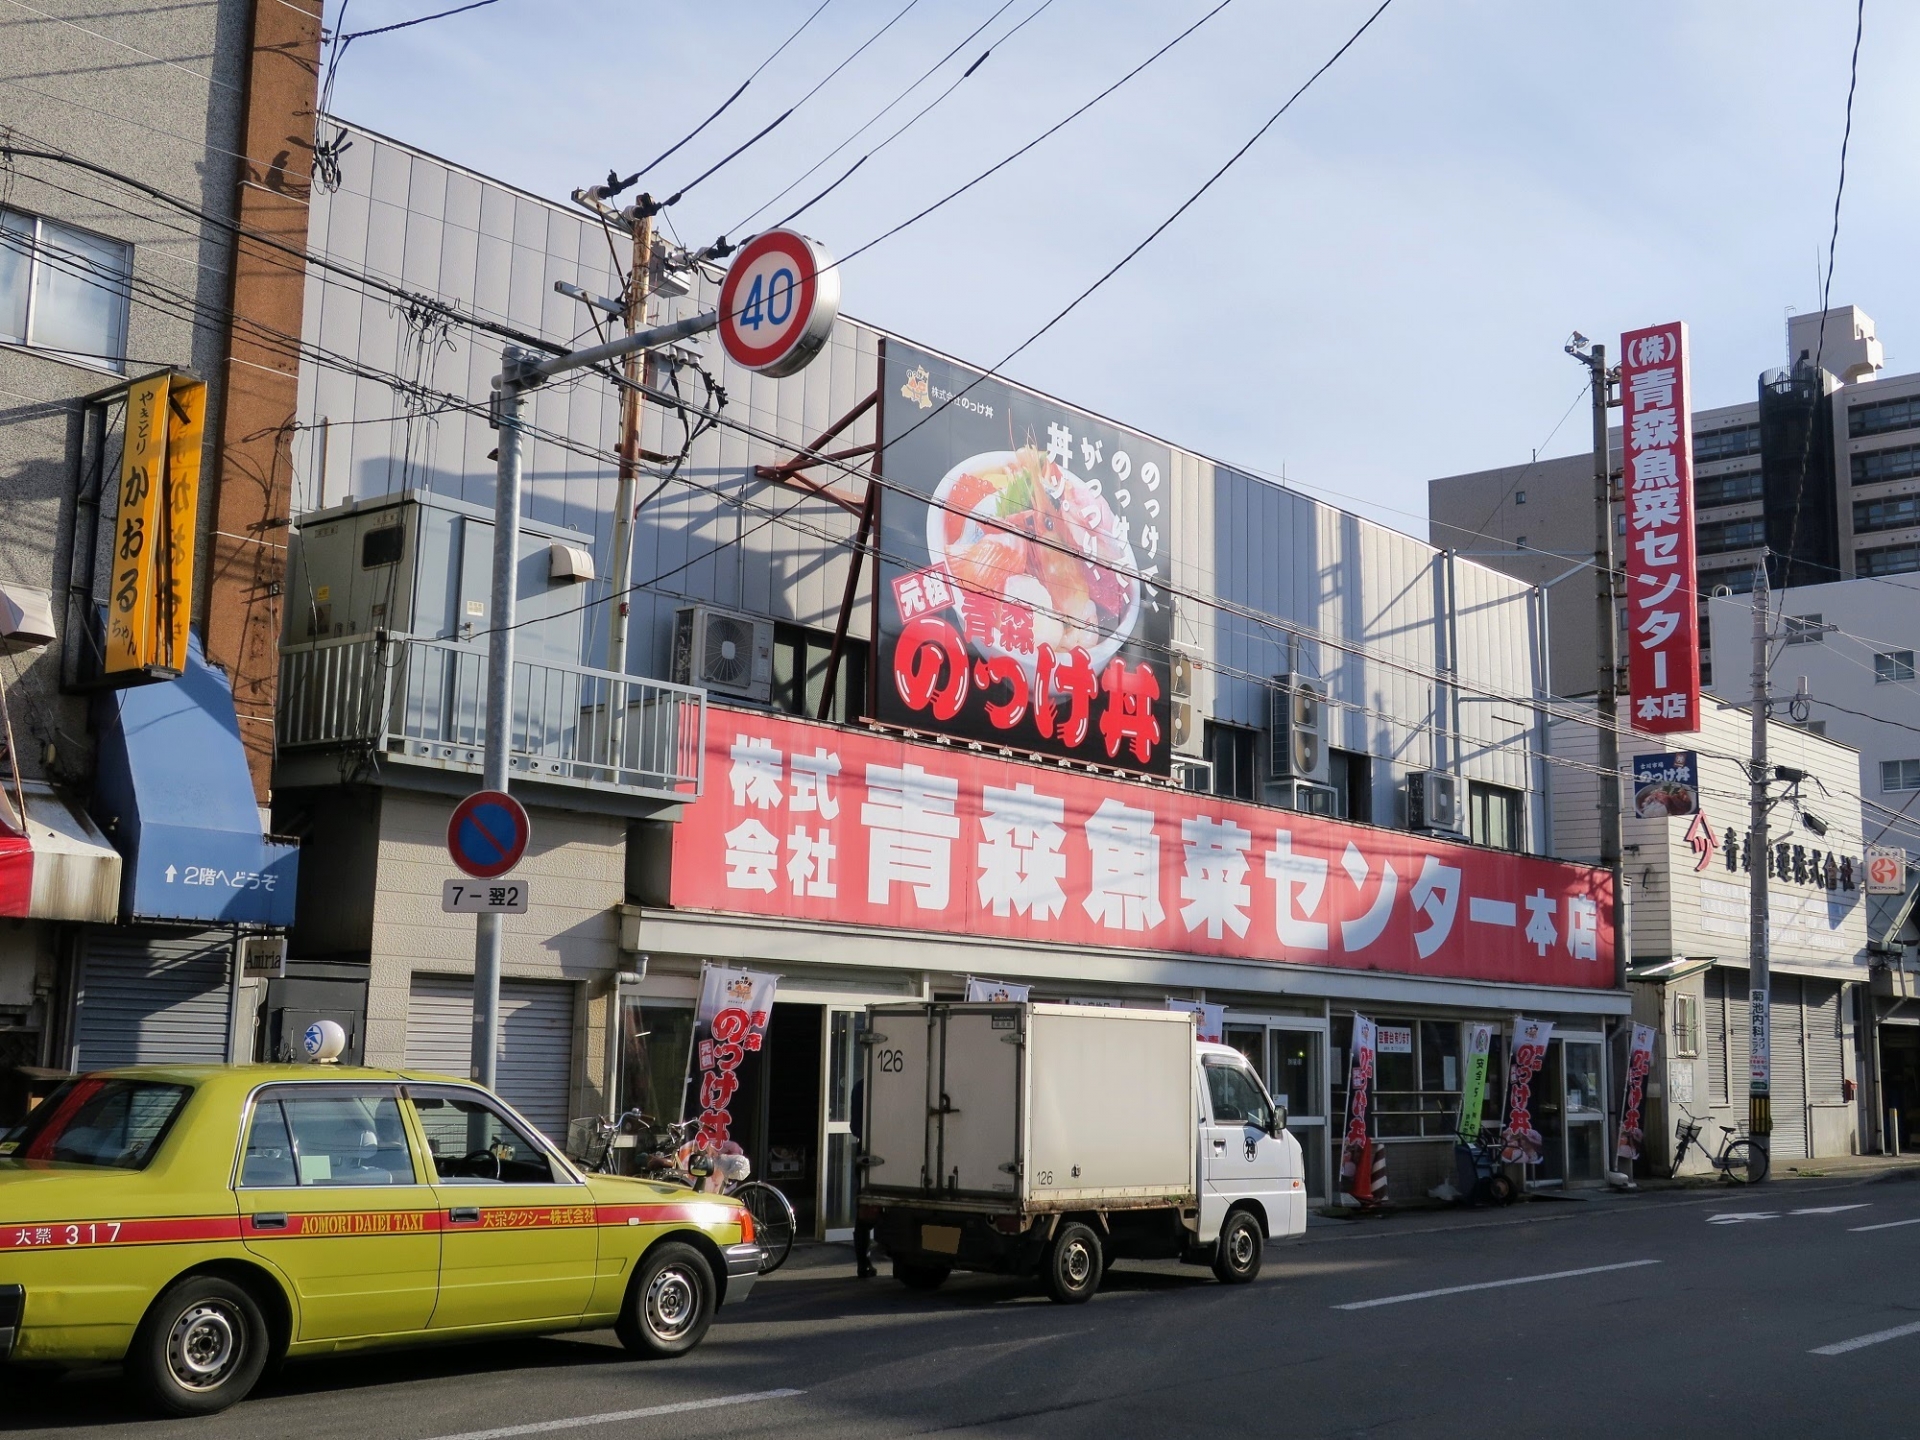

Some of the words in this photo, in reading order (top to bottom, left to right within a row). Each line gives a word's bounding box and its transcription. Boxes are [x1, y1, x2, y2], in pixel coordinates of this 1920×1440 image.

[740, 268, 793, 330] 40
[135, 390, 154, 456] やきとり
[894, 616, 1161, 764] のっけ丼
[184, 866, 278, 891] 2階へどうぞ
[877, 1050, 903, 1073] 126
[1036, 1170, 1053, 1186] 126
[301, 1215, 352, 1234] AOMORI
[355, 1214, 391, 1232] DAIEI
[393, 1213, 424, 1231] TAXI
[483, 1208, 595, 1228] 大栄タクシー株式会社
[65, 1222, 121, 1245] 317
